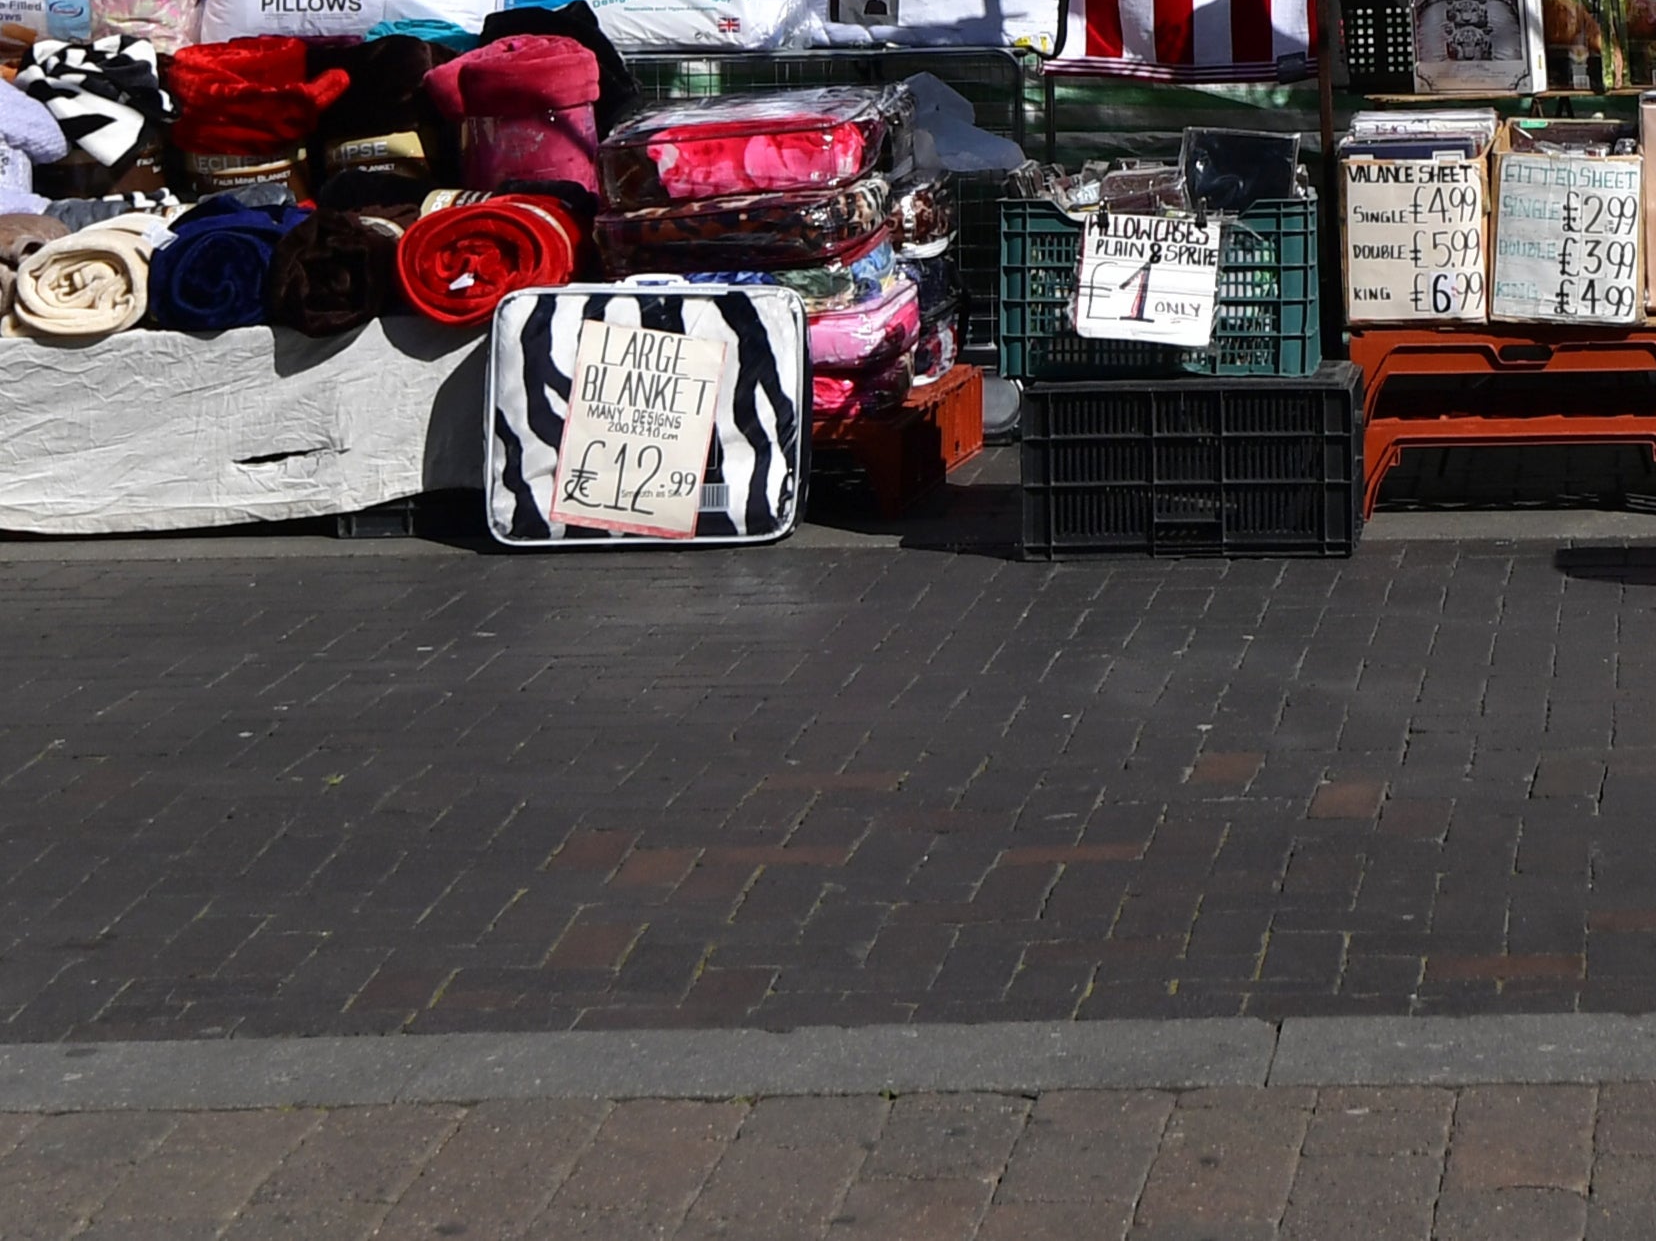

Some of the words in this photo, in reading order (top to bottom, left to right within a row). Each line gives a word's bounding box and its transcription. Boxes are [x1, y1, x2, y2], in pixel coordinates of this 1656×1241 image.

[257, 169, 293, 184] BLANKET
[1347, 165, 1414, 183] VALANCE
[1418, 165, 1473, 184] SHEET
[1503, 164, 1576, 187] FITTED
[1578, 167, 1638, 189] SHEET
[1353, 206, 1408, 224] SINGLE
[1408, 185, 1477, 224] £4.99
[1502, 195, 1561, 221] SINGLE
[1096, 239, 1145, 258] PLAIN
[1149, 242, 1163, 264] &
[1353, 244, 1408, 260] DOUBLE
[1409, 229, 1480, 269] £5.99
[1498, 239, 1557, 260] DOUBLE
[1078, 260, 1155, 323] £1
[1353, 287, 1392, 301] KING
[1495, 281, 1540, 301] KING
[1154, 301, 1201, 318] ONLY
[601, 326, 694, 377] LARGE
[581, 364, 716, 416] BLANKET
[586, 404, 625, 423] MANY
[632, 409, 682, 430] DESIGNS
[662, 432, 679, 441] cm
[563, 440, 698, 516] £12.99
